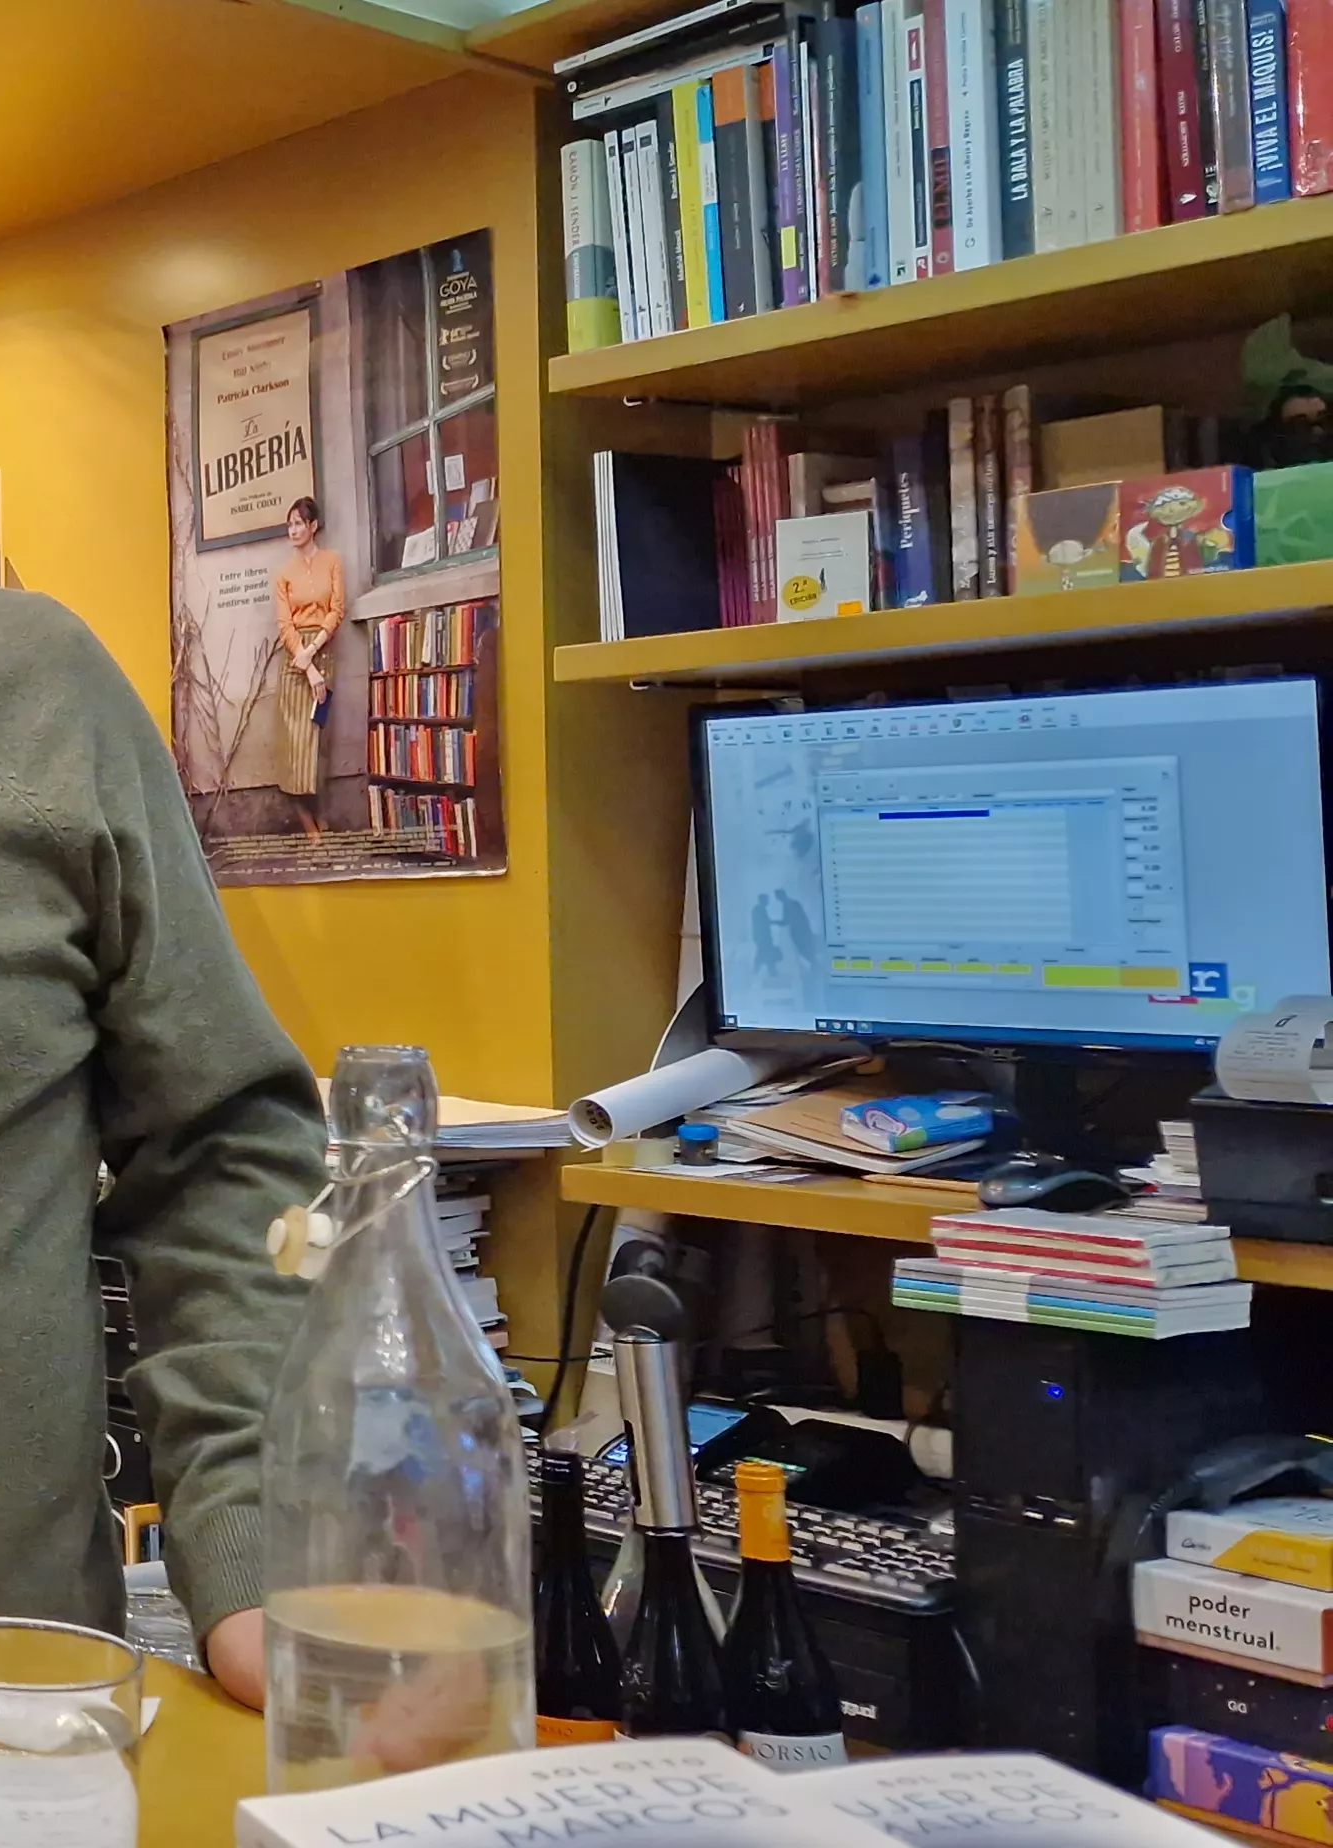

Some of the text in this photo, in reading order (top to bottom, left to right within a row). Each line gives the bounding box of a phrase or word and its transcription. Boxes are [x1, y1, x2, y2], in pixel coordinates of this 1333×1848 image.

[1249, 29, 1284, 172] ¡VIVA EL MAQUIS!
[1007, 58, 1029, 202] LA BALA Y LA PALABRA
[568, 151, 578, 192] RAMÓN
[572, 206, 580, 247] SENDER
[966, 217, 974, 228] De
[439, 276, 478, 298] GOYA
[217, 379, 290, 404] Patricia Clarkson
[204, 420, 308, 498] LIBRERÍA
[230, 501, 255, 515] ISABEL
[257, 496, 283, 511] COIXET
[898, 472, 920, 549] Periquetes
[220, 567, 268, 582] Entre libros
[219, 580, 269, 595] nadie puede
[217, 594, 270, 609] sentirse solo
[1191, 970, 1220, 992] r
[1189, 1594, 1251, 1619] poder
[532, 1756, 707, 1781] SOL OTTO
[326, 1773, 749, 1847] LA MUJER DE
[833, 1782, 1082, 1819] UJER DE
[496, 1796, 790, 1848] MARCOS
